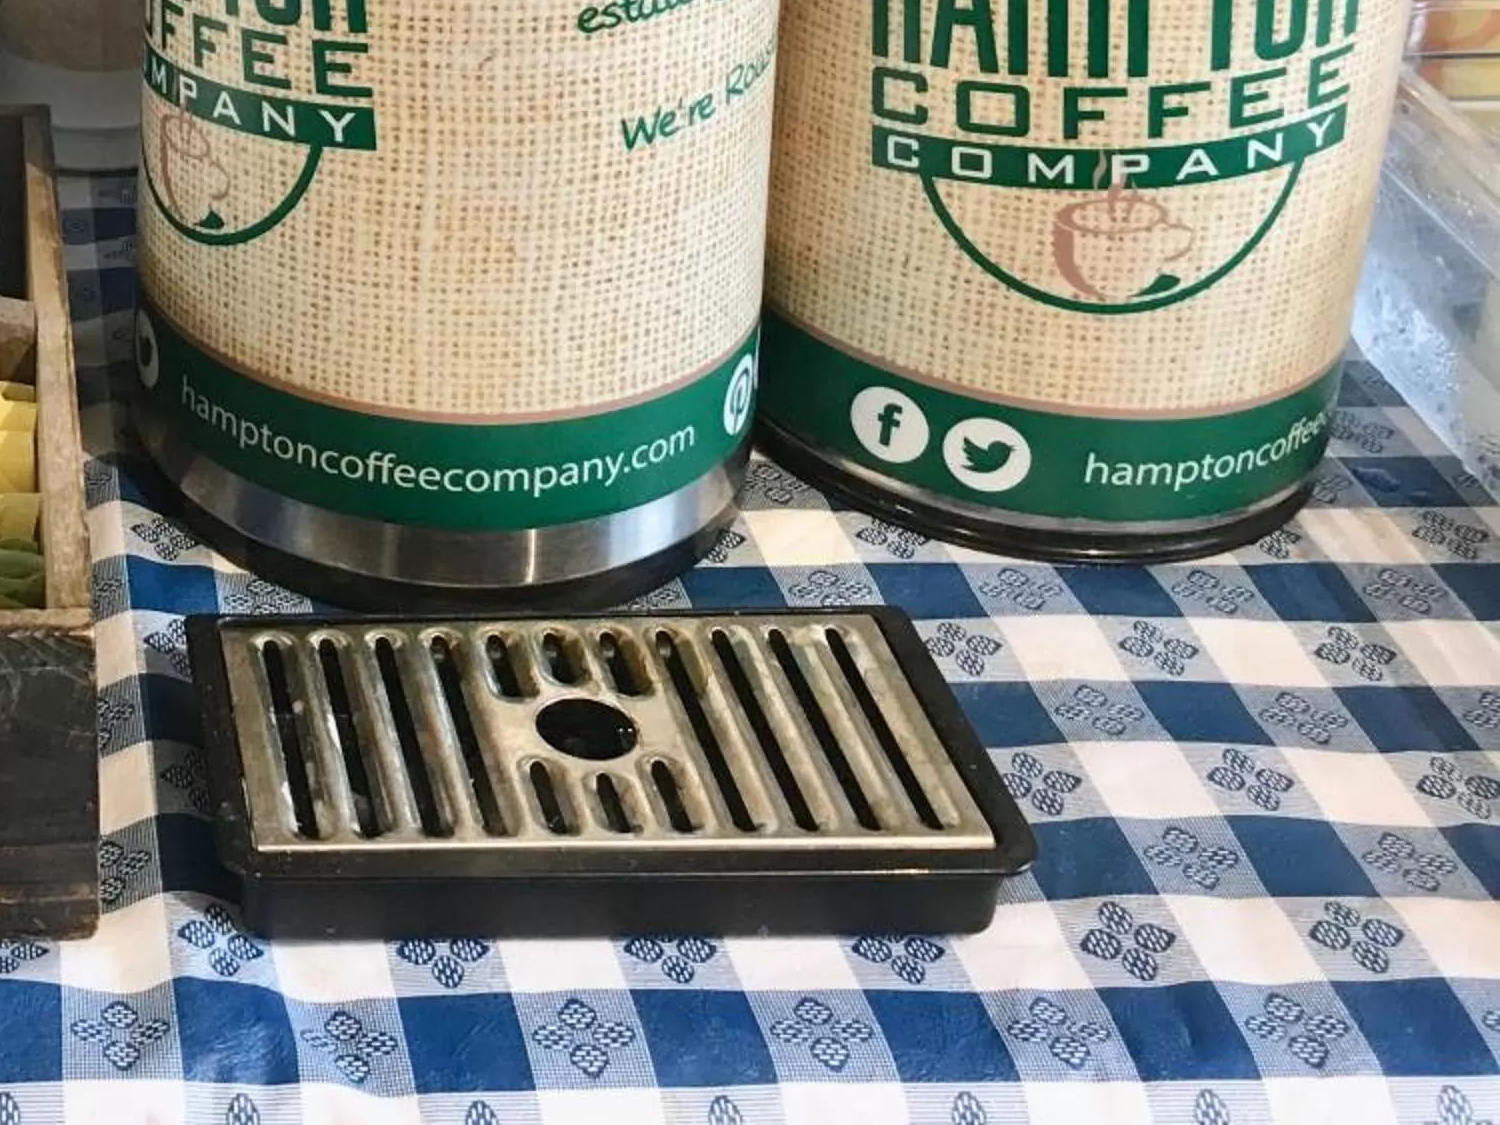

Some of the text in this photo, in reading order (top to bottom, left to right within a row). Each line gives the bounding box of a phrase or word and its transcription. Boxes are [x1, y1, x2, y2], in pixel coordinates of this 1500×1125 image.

[146, 55, 358, 144] MPANY
[619, 94, 717, 151] We're
[870, 43, 1355, 141] COFFEE
[885, 119, 1338, 186] COMPANY
[180, 375, 695, 501] hamptoncoffeecompany.com
